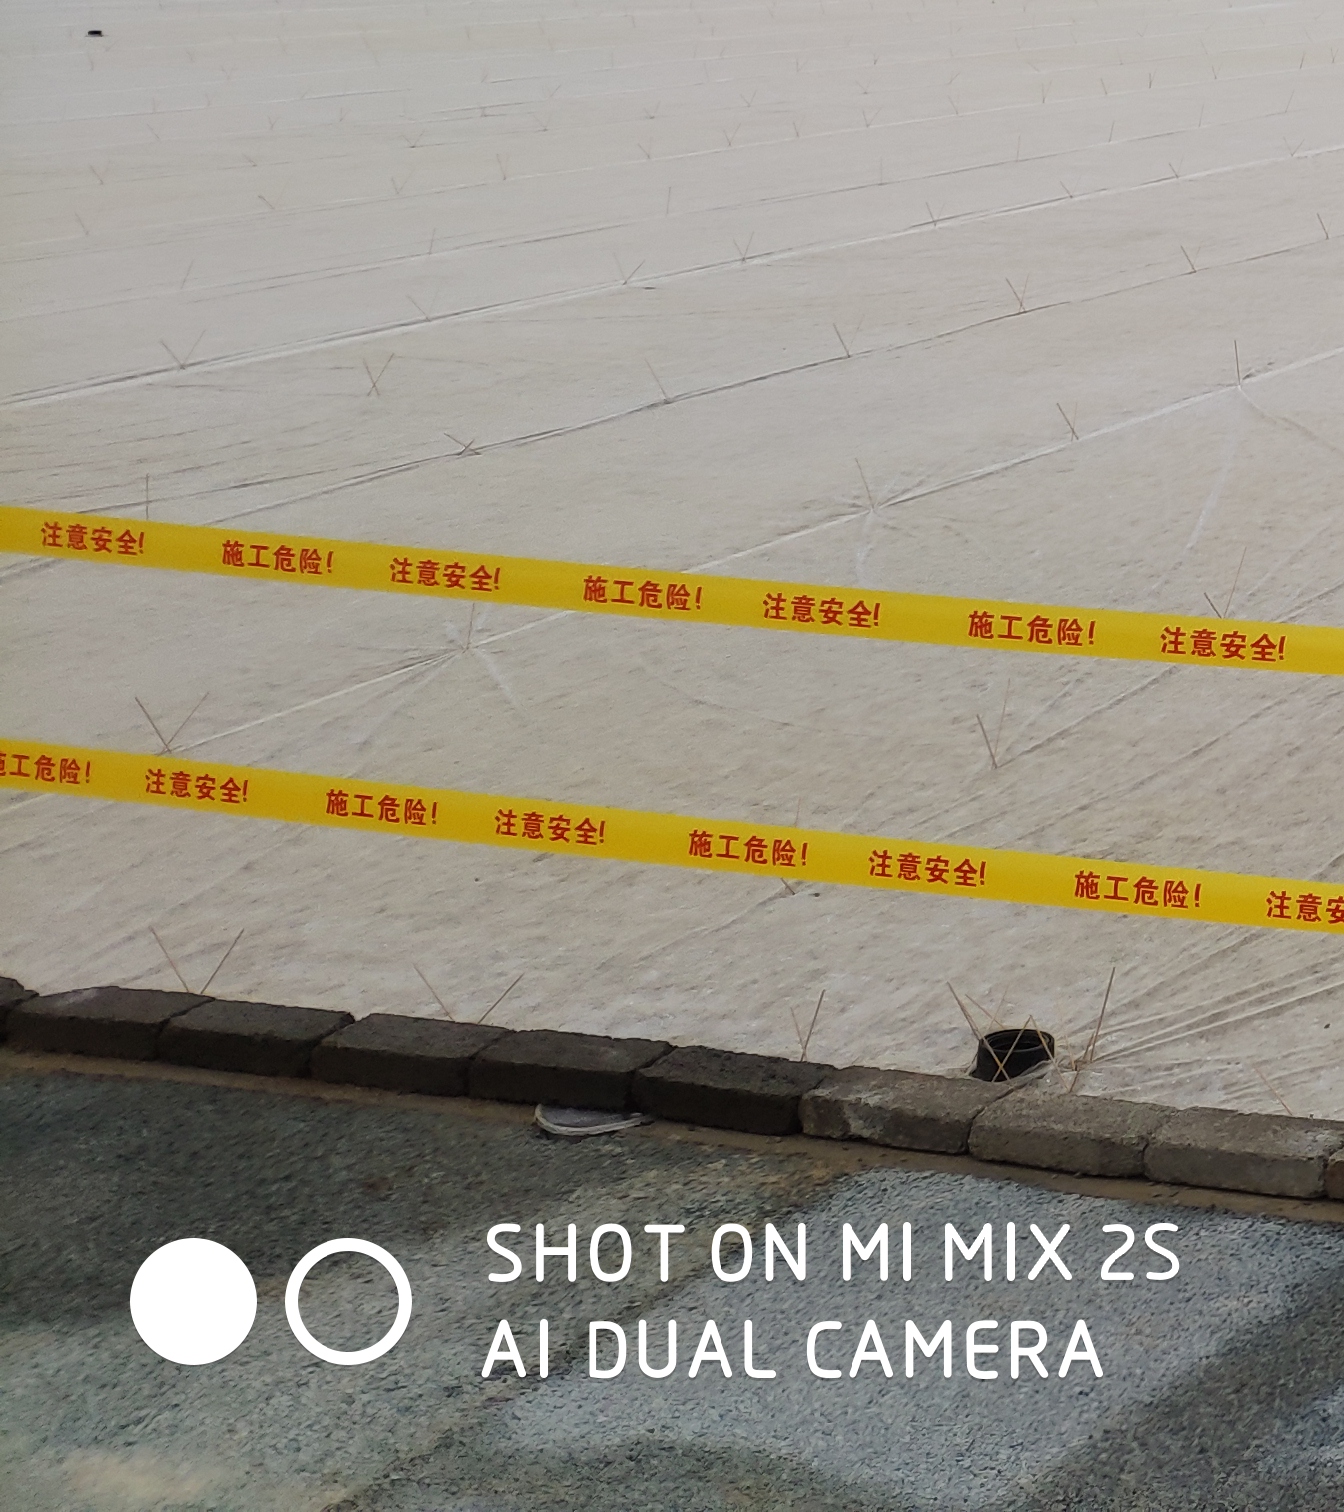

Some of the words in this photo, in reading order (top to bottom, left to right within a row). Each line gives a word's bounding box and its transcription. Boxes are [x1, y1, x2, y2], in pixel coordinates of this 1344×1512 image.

[40, 520, 145, 557] 注意安全!
[220, 538, 334, 577] 施工危险!
[389, 556, 501, 594] 注意安全!
[581, 573, 703, 612] 施工危险!
[761, 591, 881, 629] 注意安全!
[966, 608, 1097, 648] 施工危险!
[1158, 625, 1287, 664] 注意安全!
[144, 767, 250, 805] 注意安全!
[324, 788, 439, 827] 施工危险!
[493, 807, 607, 847] 注意安全!
[686, 828, 809, 869] 施工危险!
[867, 848, 987, 889] 注意安全!
[1072, 869, 1202, 911] 施工危险!
